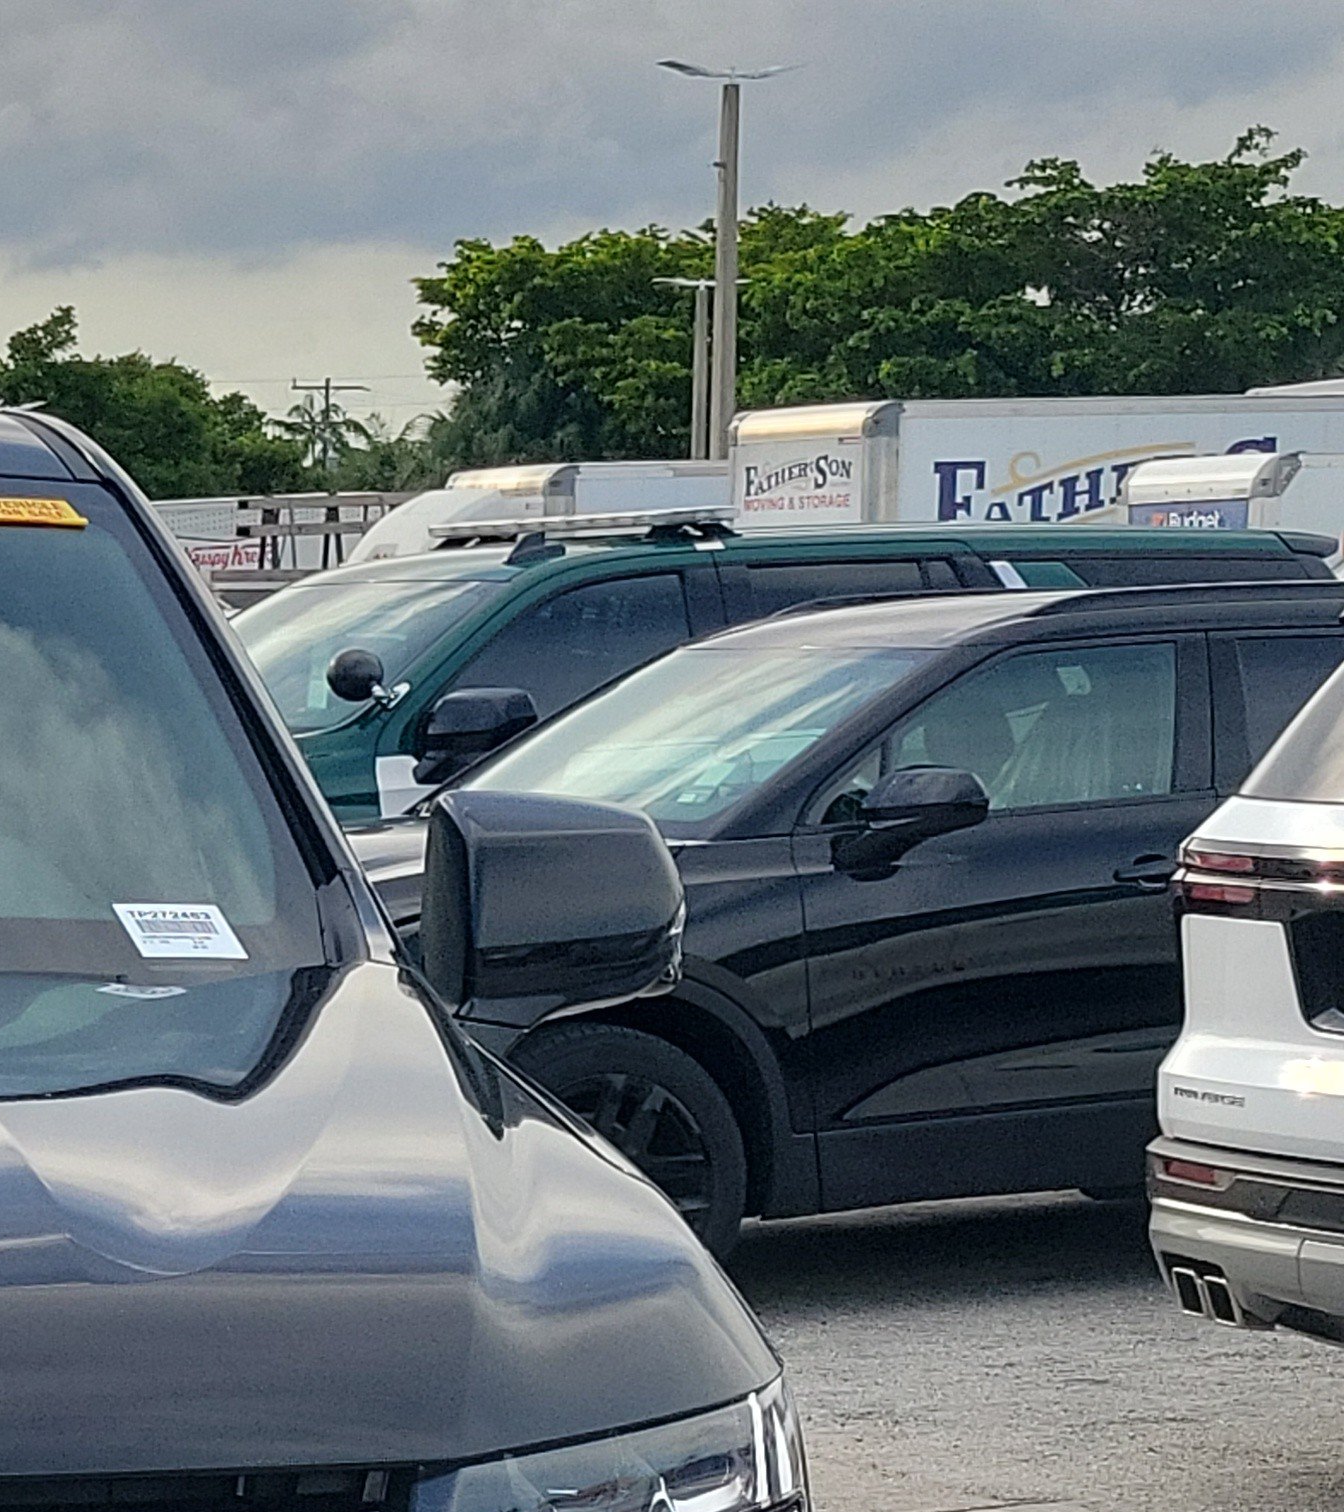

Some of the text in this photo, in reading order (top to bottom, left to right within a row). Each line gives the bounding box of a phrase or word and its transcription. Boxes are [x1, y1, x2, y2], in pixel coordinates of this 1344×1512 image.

[745, 461, 809, 496] FATHER
[814, 454, 853, 489] SON
[933, 461, 1137, 522] FATH
